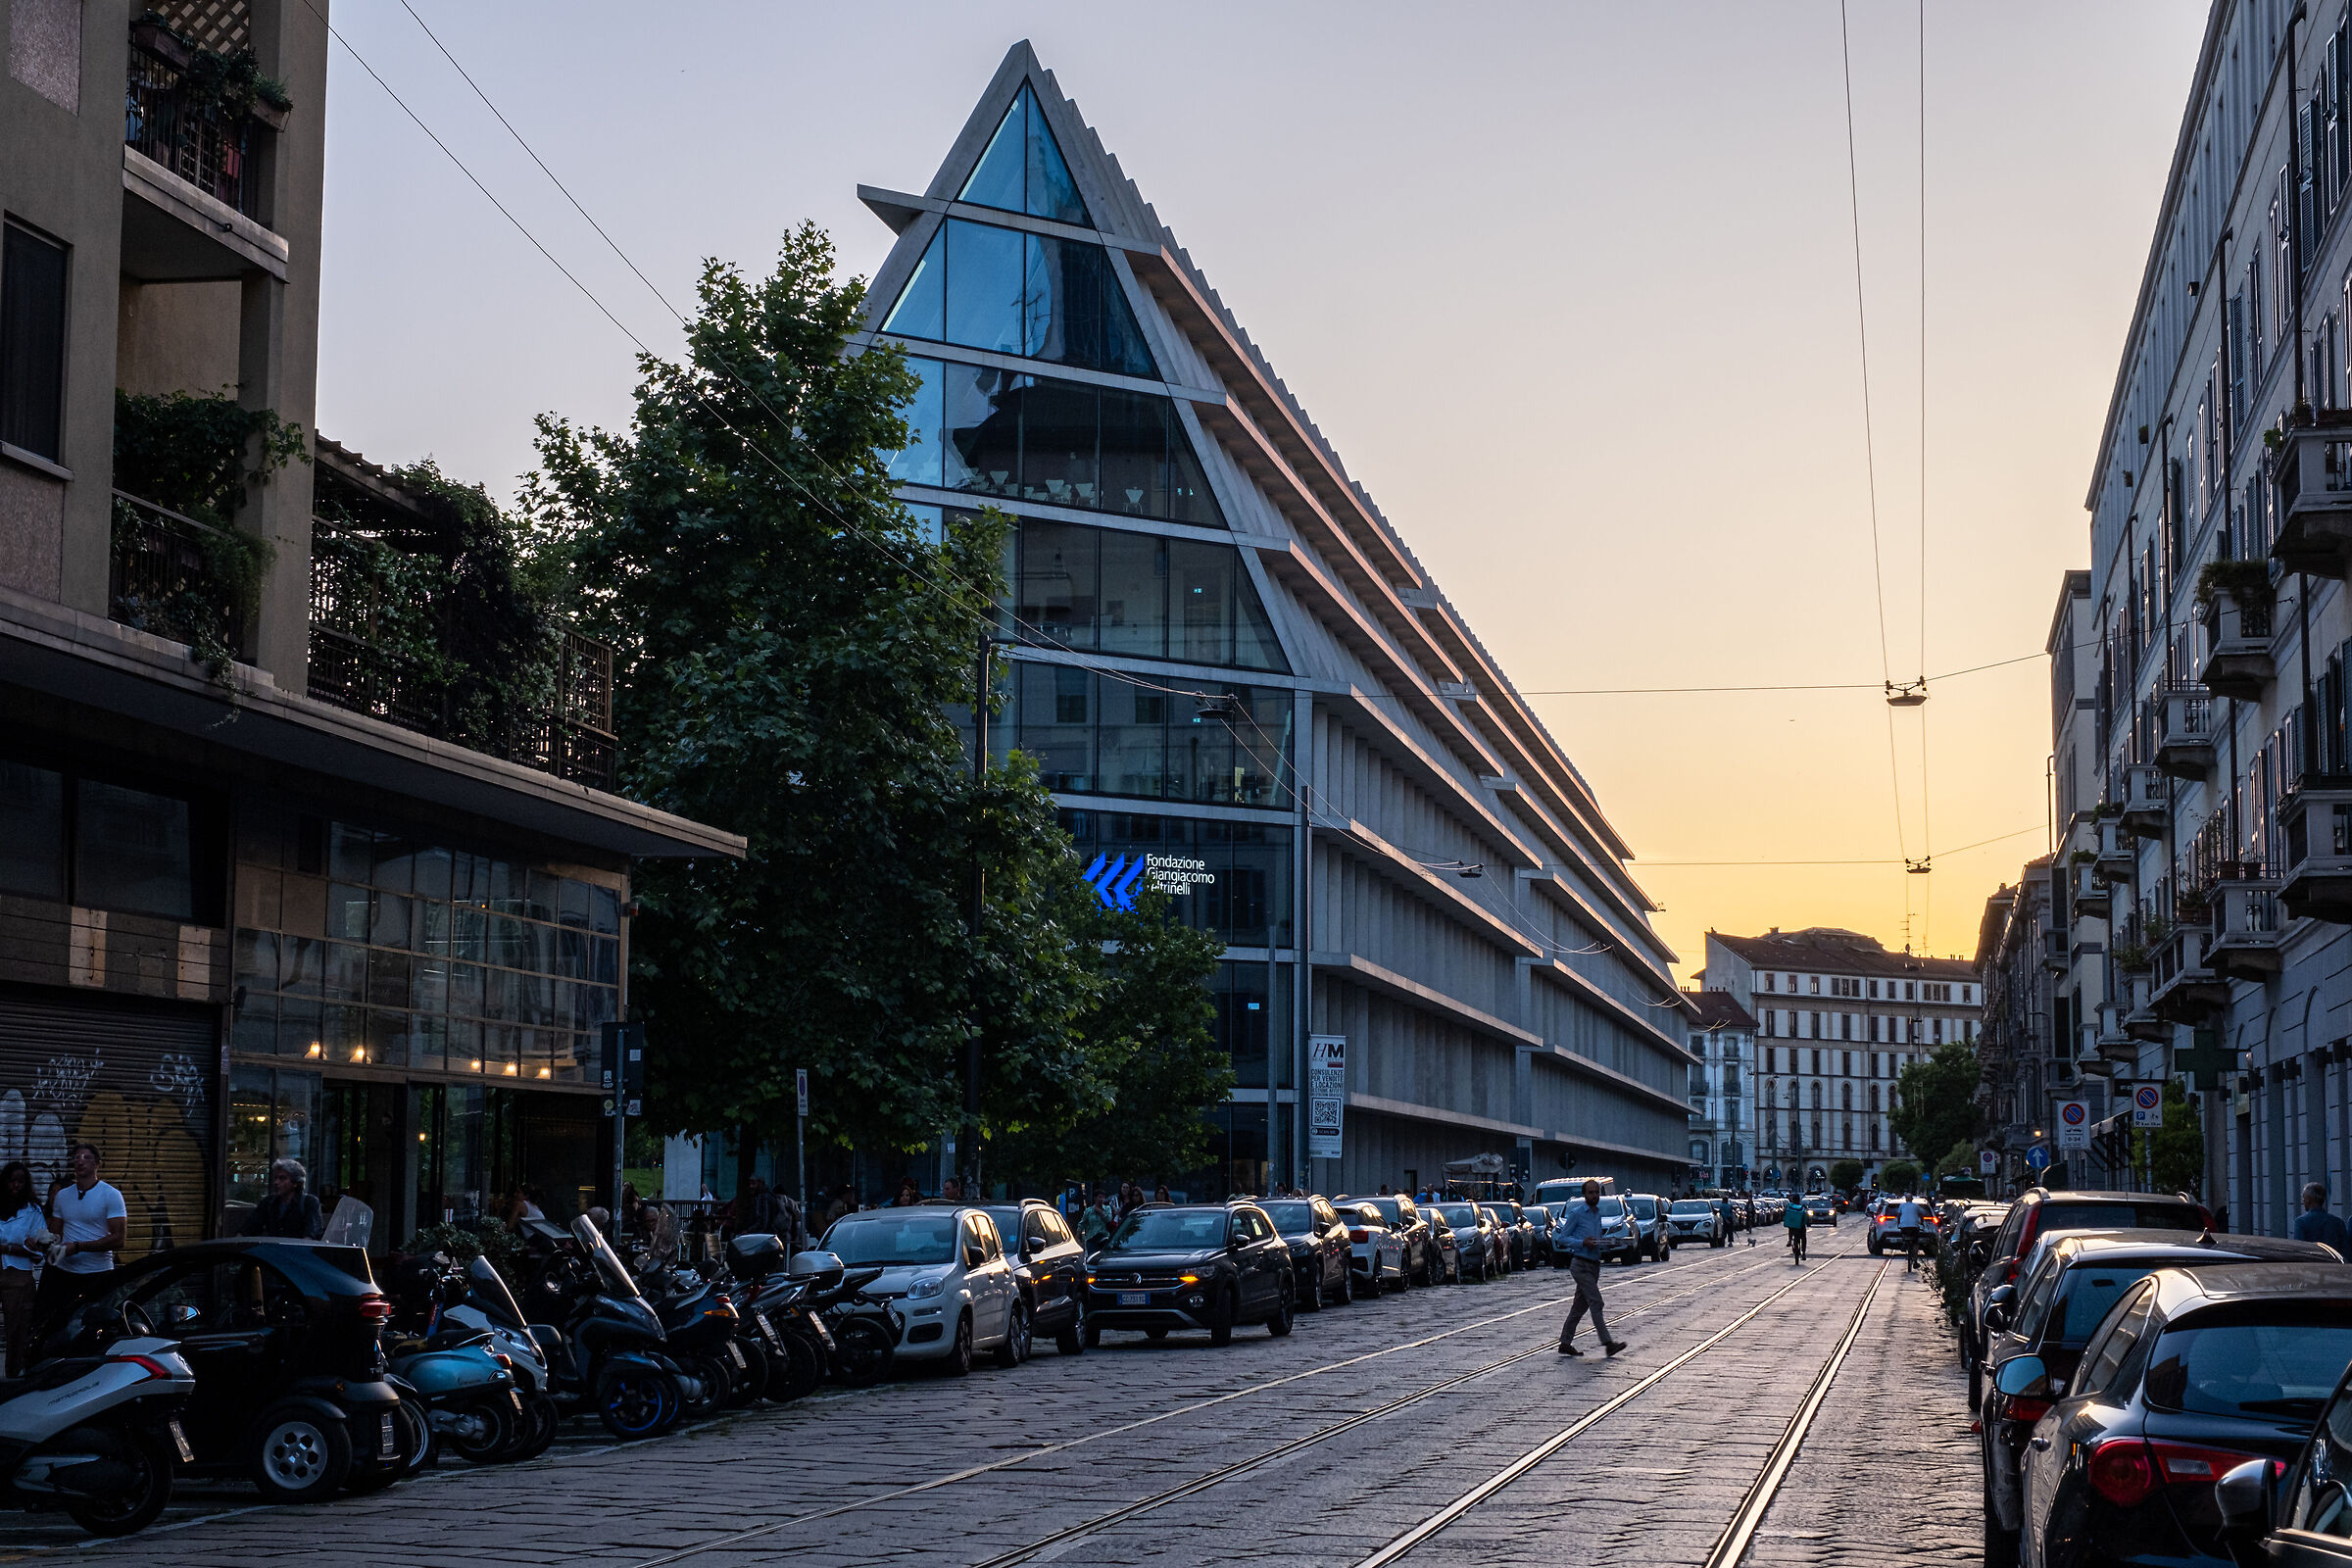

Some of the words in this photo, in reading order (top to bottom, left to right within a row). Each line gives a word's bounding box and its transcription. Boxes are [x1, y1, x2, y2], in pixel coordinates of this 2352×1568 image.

[1147, 854, 1205, 870] Fondazione
[1147, 867, 1215, 884] Giangiacomo
[1147, 880, 1191, 896] eltrinelli
[1313, 1043, 1345, 1058] HM
[1068, 1188, 1075, 1198] P
